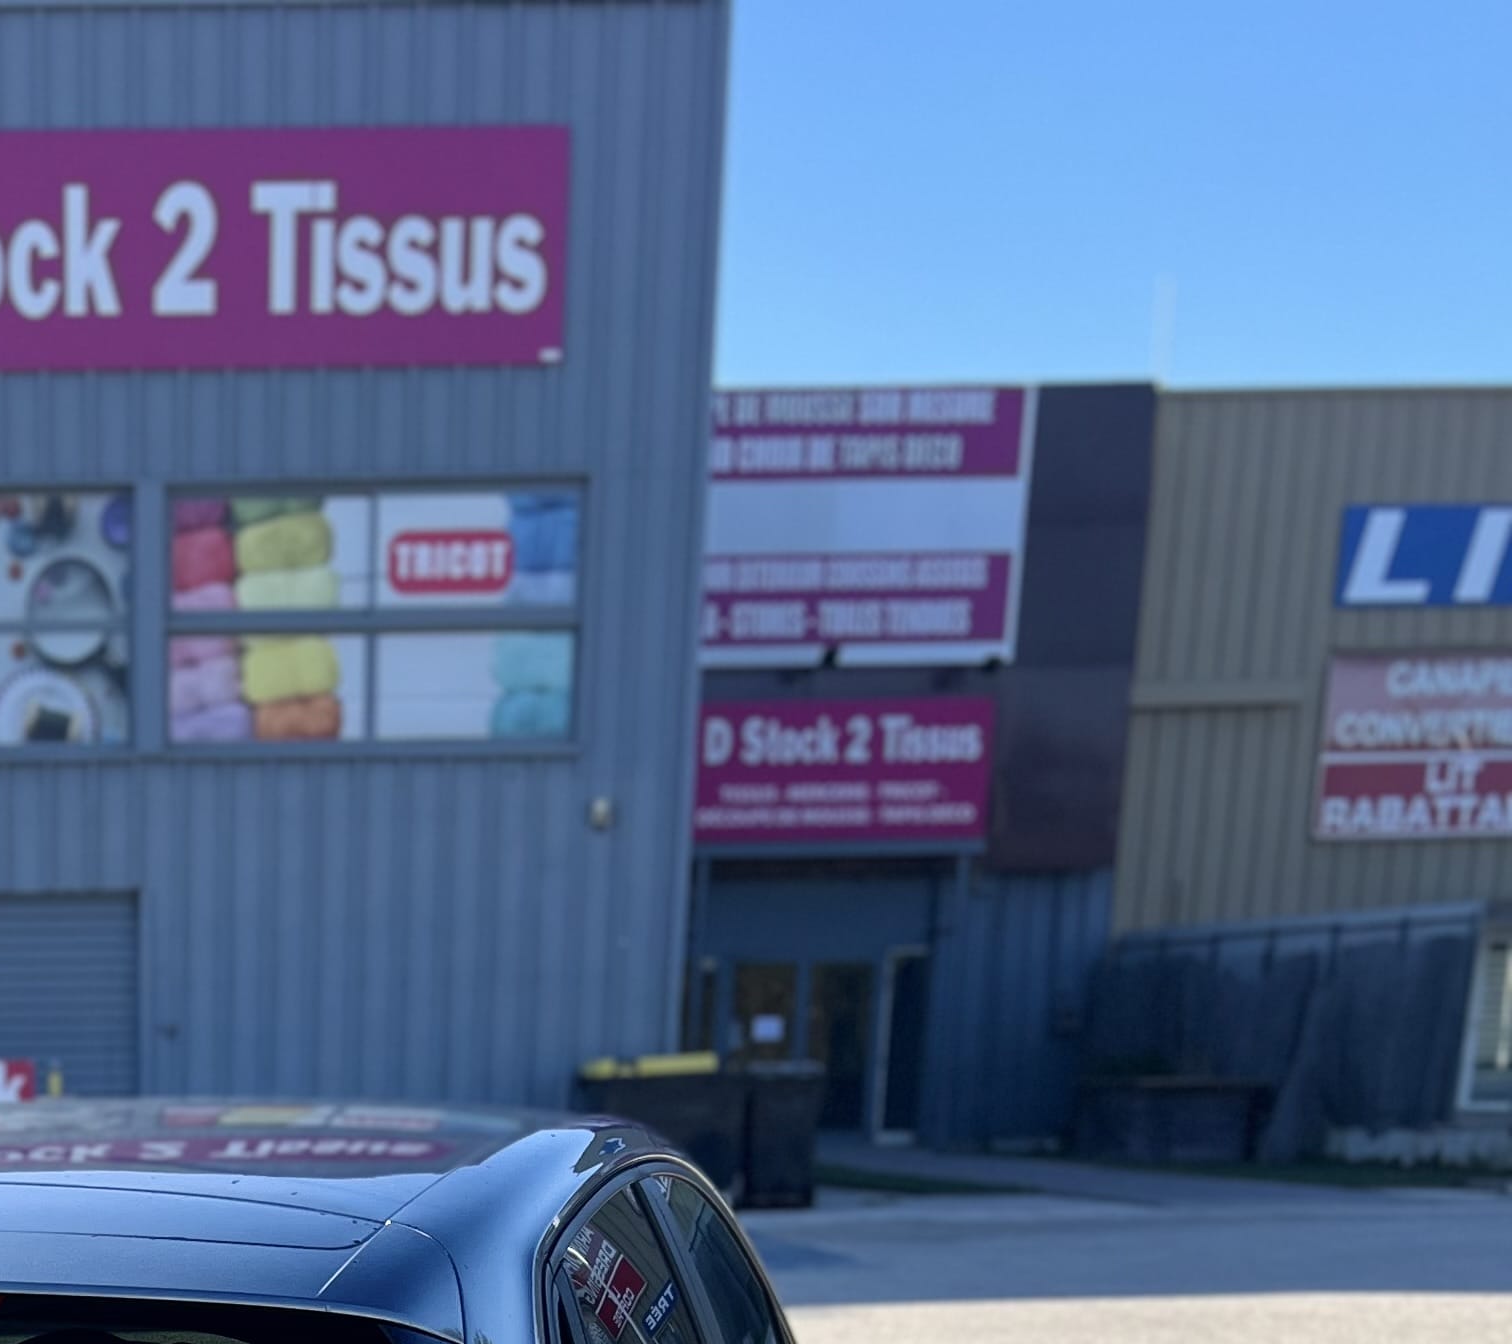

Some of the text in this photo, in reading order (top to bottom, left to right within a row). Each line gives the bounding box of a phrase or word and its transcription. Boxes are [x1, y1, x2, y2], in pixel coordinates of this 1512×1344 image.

[151, 180, 219, 316] 2
[251, 180, 548, 316] Tissus
[395, 539, 509, 580] TRICOT
[703, 713, 983, 766] D Stock 2 Tissus
[1321, 794, 1512, 834] RABATTA
